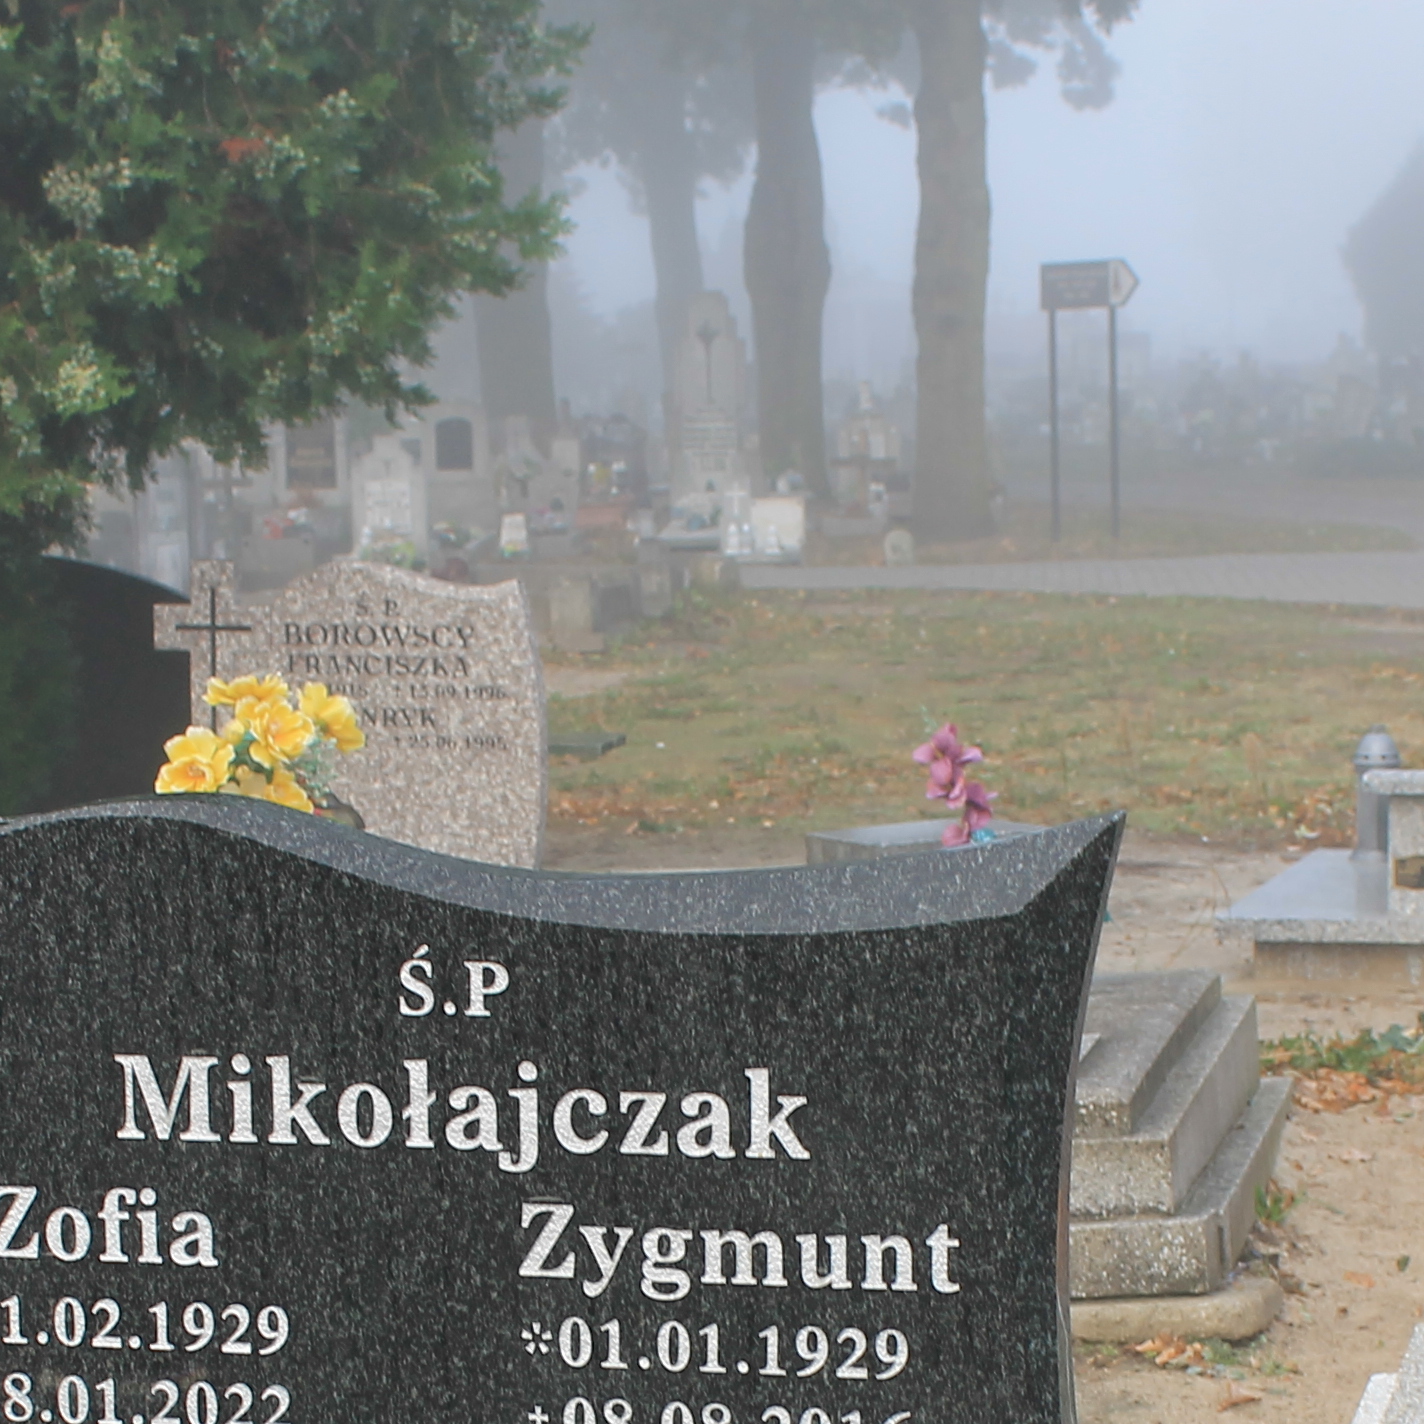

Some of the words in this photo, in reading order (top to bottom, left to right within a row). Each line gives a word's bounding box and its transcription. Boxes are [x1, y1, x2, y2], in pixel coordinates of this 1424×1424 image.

[283, 622, 474, 649] BOROWSCY
[287, 654, 469, 678] FRANCISZKA
[399, 945, 510, 1018] Ś.P
[114, 1053, 811, 1173] Mikołajczak
[518, 1202, 961, 1300] Zygmunt
